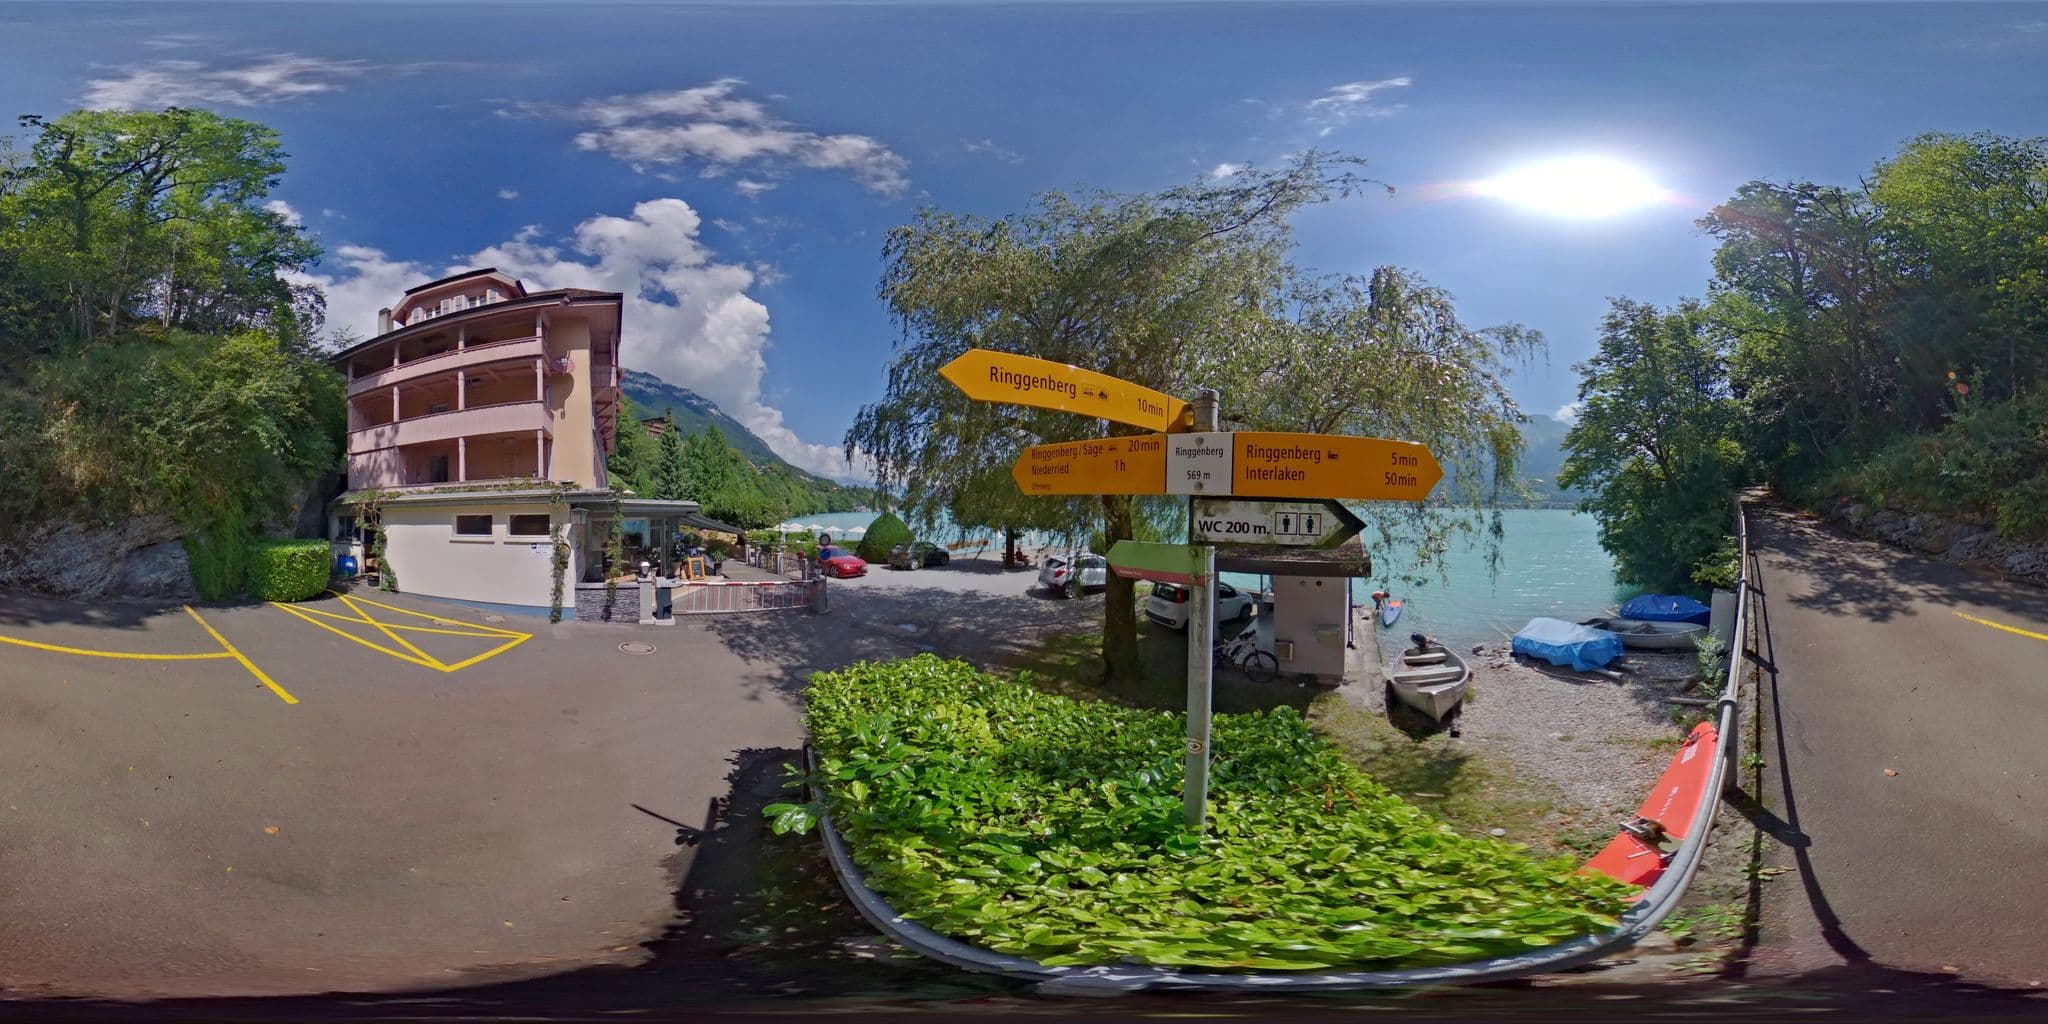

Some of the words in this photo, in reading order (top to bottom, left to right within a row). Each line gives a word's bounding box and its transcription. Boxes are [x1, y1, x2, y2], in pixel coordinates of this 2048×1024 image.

[990, 366, 1077, 398] Ringgenberg
[1175, 446, 1224, 459] Ringgenberg
[1246, 444, 1321, 464] Ringgenberg
[1031, 462, 1069, 475] Niederried
[1187, 470, 1201, 480] 569
[1203, 472, 1211, 480] m
[1246, 466, 1305, 481] Interlaken
[1198, 520, 1222, 533] WC
[1225, 521, 1250, 534] 200
[1253, 525, 1270, 535] m.
